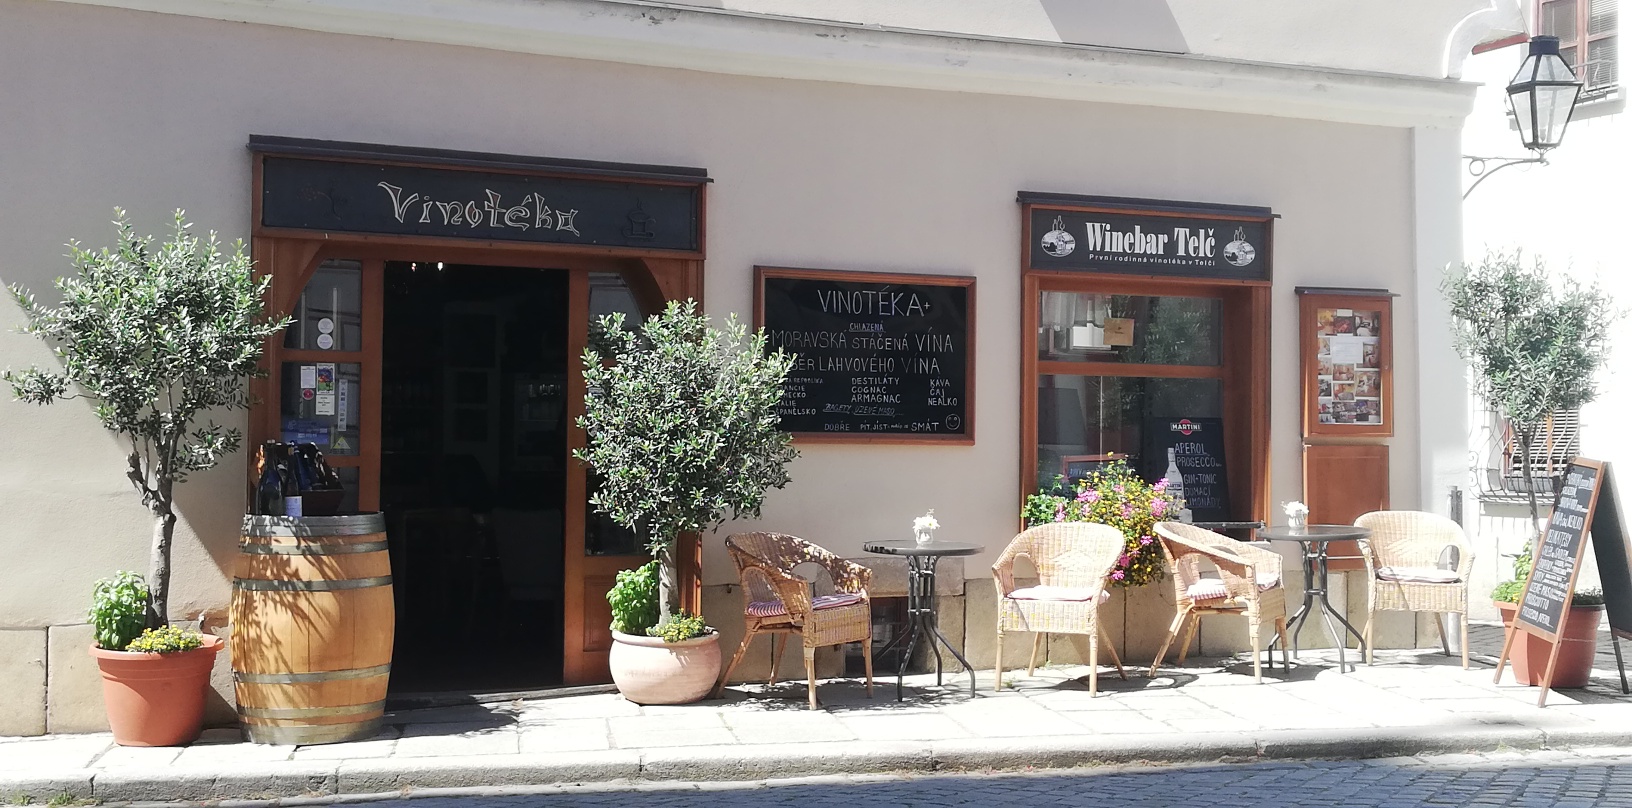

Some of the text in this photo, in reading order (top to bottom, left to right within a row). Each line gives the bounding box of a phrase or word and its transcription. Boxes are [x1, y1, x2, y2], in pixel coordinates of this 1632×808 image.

[377, 180, 581, 238] Vinotéka
[1085, 222, 1216, 258] Winebar Telč
[1089, 253, 1112, 261] První
[1114, 255, 1147, 263] rodinná
[1150, 257, 1186, 265] vinotéka
[1195, 259, 1216, 267] Telči
[851, 332, 909, 351] STÁČENÁ
[914, 327, 954, 353] VÍNA
[818, 353, 895, 373] LAHVOVÉHO
[901, 354, 941, 374] VÍNA
[851, 373, 900, 385] DESTILÁTY
[929, 376, 951, 388] KÁVA
[851, 386, 887, 394] COGNAC
[850, 394, 901, 403] ARMAGNAC
[927, 397, 958, 406] NEALKO
[824, 421, 850, 431] DOBŘE
[911, 418, 940, 431] SMÁT
[1174, 442, 1206, 454] APEROL
[1183, 473, 1217, 484] GIN-TONIC
